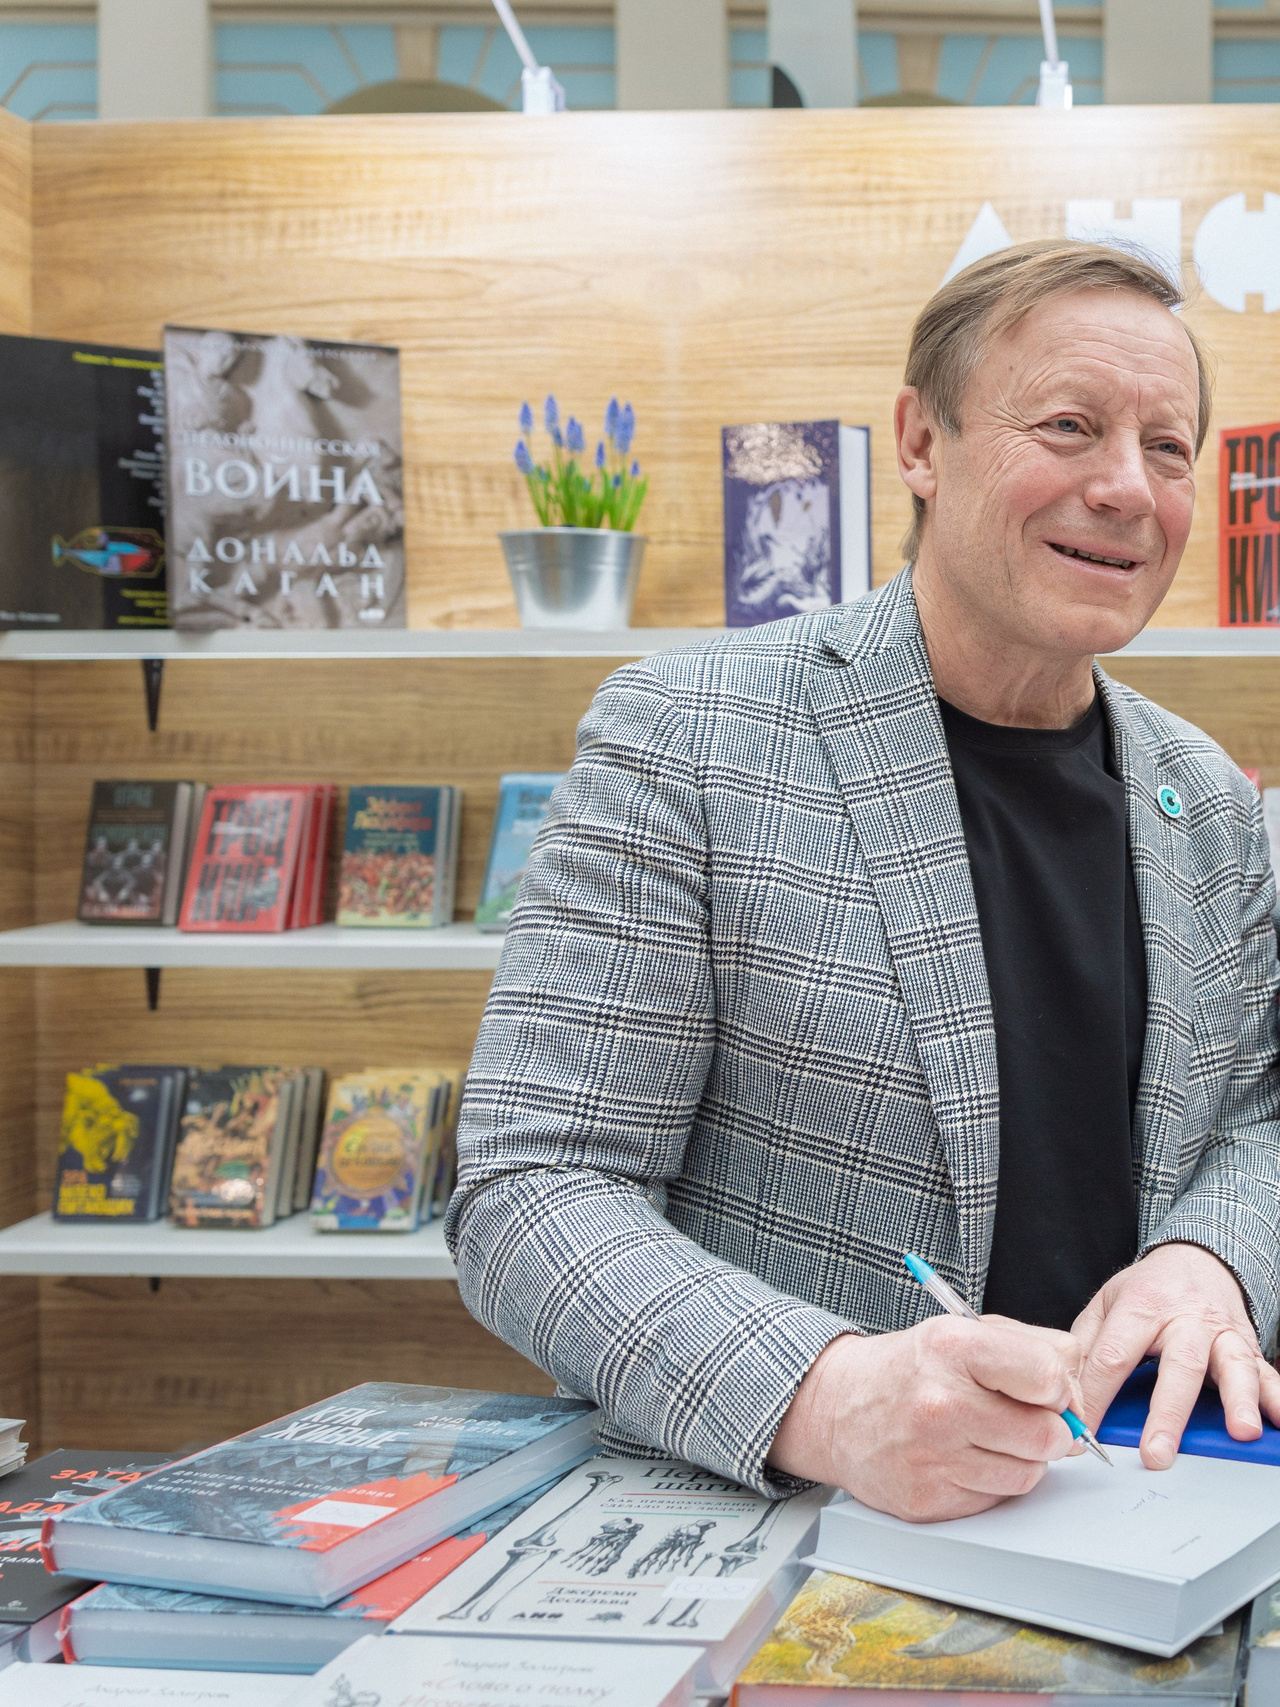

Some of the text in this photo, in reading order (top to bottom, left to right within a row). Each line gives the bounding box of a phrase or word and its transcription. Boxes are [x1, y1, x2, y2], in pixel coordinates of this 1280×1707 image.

[184, 453, 384, 506] ВОЙНА
[186, 536, 385, 568] ДОНАЛЬД
[189, 567, 385, 600] КАГАН
[300, 1406, 388, 1426] КАК
[426, 1415, 503, 1427] АНДРЕЙ
[260, 1422, 409, 1450] ЖИВЫЕ
[172, 1470, 245, 1482] ДВУНОГИЕ
[143, 1484, 220, 1497] ЖИВОТНЫЕ
[171, 1479, 227, 1490] ДРУГИЕ
[230, 1483, 327, 1498] ИСЧЕЗНУВШИЕ
[650, 1481, 744, 1492] шаги
[640, 1498, 758, 1508] ПРЯМОХОЖДЕНИЕ
[548, 1586, 638, 1598] Джереми
[537, 1595, 630, 1606] Десильва
